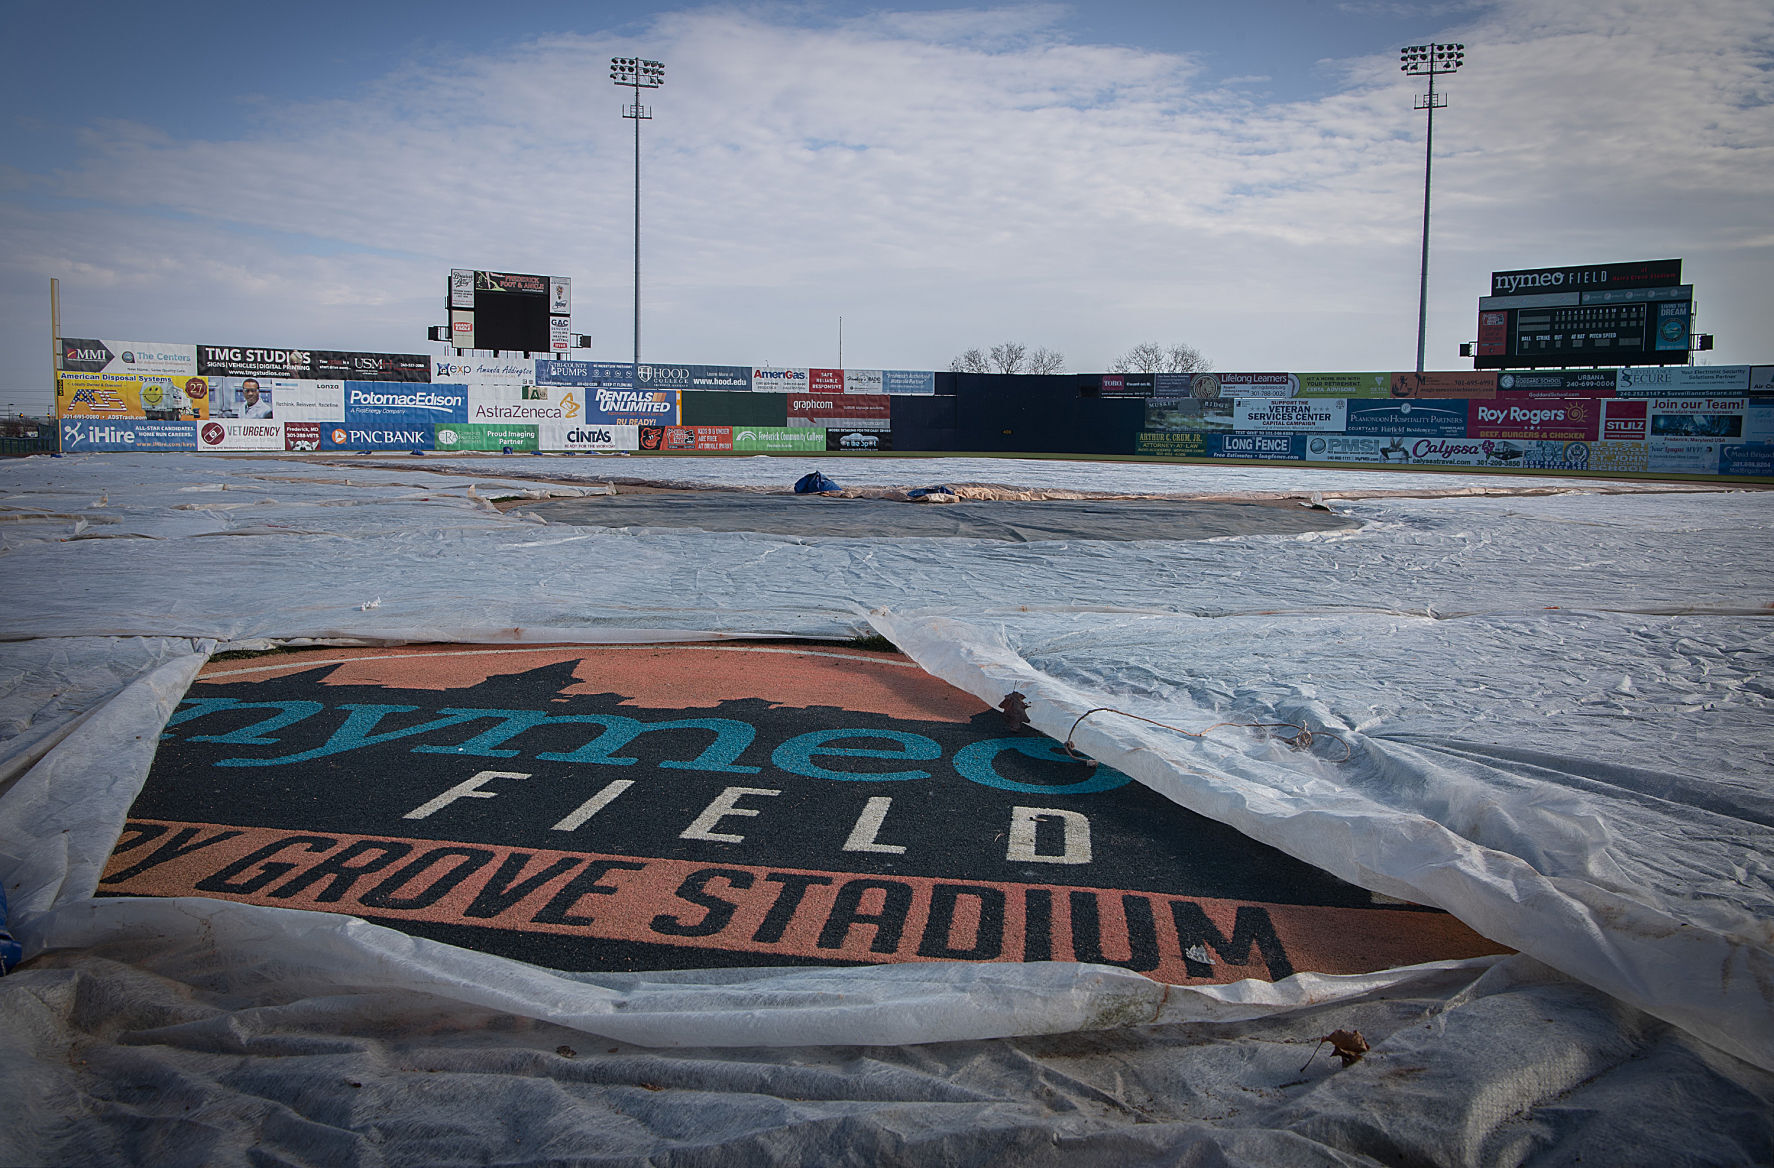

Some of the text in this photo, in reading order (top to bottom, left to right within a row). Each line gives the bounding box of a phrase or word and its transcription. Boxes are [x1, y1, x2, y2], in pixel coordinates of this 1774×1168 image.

[1496, 270, 1607, 292] nymeo FIELD
[77, 349, 106, 360] MMI
[156, 353, 191, 361] Centers
[206, 348, 241, 361] TMG
[450, 366, 471, 375] exp
[557, 368, 587, 376] PUMPS
[654, 369, 690, 378] HOOD
[102, 374, 136, 382] Disposal
[1222, 374, 1287, 384] Lifelong Learners
[191, 383, 203, 393] 27
[595, 389, 653, 402] RENTALS
[600, 402, 670, 412] UNLIMITED
[794, 400, 833, 410] graphcom
[1652, 400, 1678, 410] Join
[1706, 400, 1744, 409] Team!
[476, 405, 562, 418] AstraZeneca
[1478, 407, 1565, 424] Roy Rogers
[1606, 421, 1644, 430] STULZ
[89, 426, 135, 443] iHire
[227, 426, 280, 436] VET URGENCY
[807, 432, 824, 442] College
[1140, 433, 1164, 441] ARTHUR
[1226, 437, 1287, 451] LONG FENCE
[1413, 439, 1479, 458] Calyssa
[402, 769, 1093, 865] FIELD
[194, 835, 648, 927] GROVE
[650, 867, 1295, 983] STADIUM
